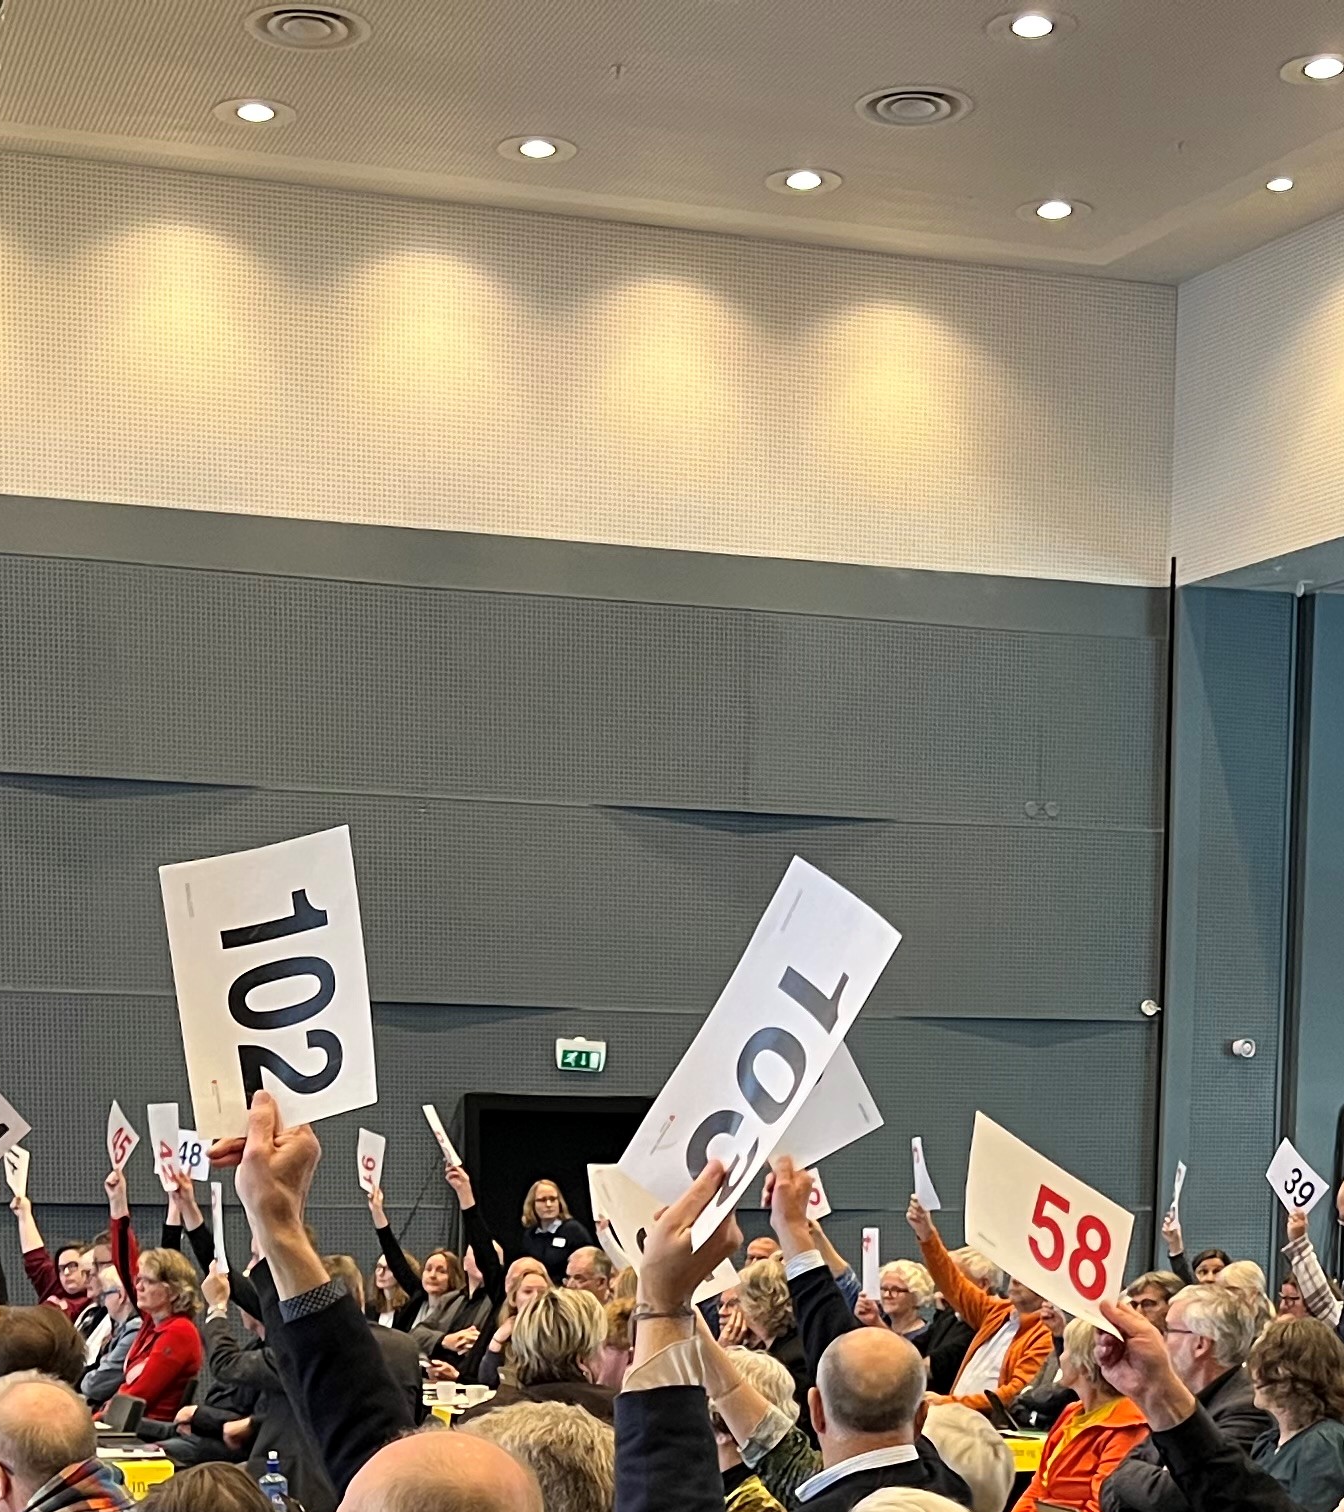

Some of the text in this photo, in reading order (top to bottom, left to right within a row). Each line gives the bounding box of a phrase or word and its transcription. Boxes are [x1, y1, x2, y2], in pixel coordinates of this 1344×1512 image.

[220, 889, 343, 1110] 102
[1027, 1184, 1111, 1301] 58
[1284, 1168, 1315, 1207] 39
